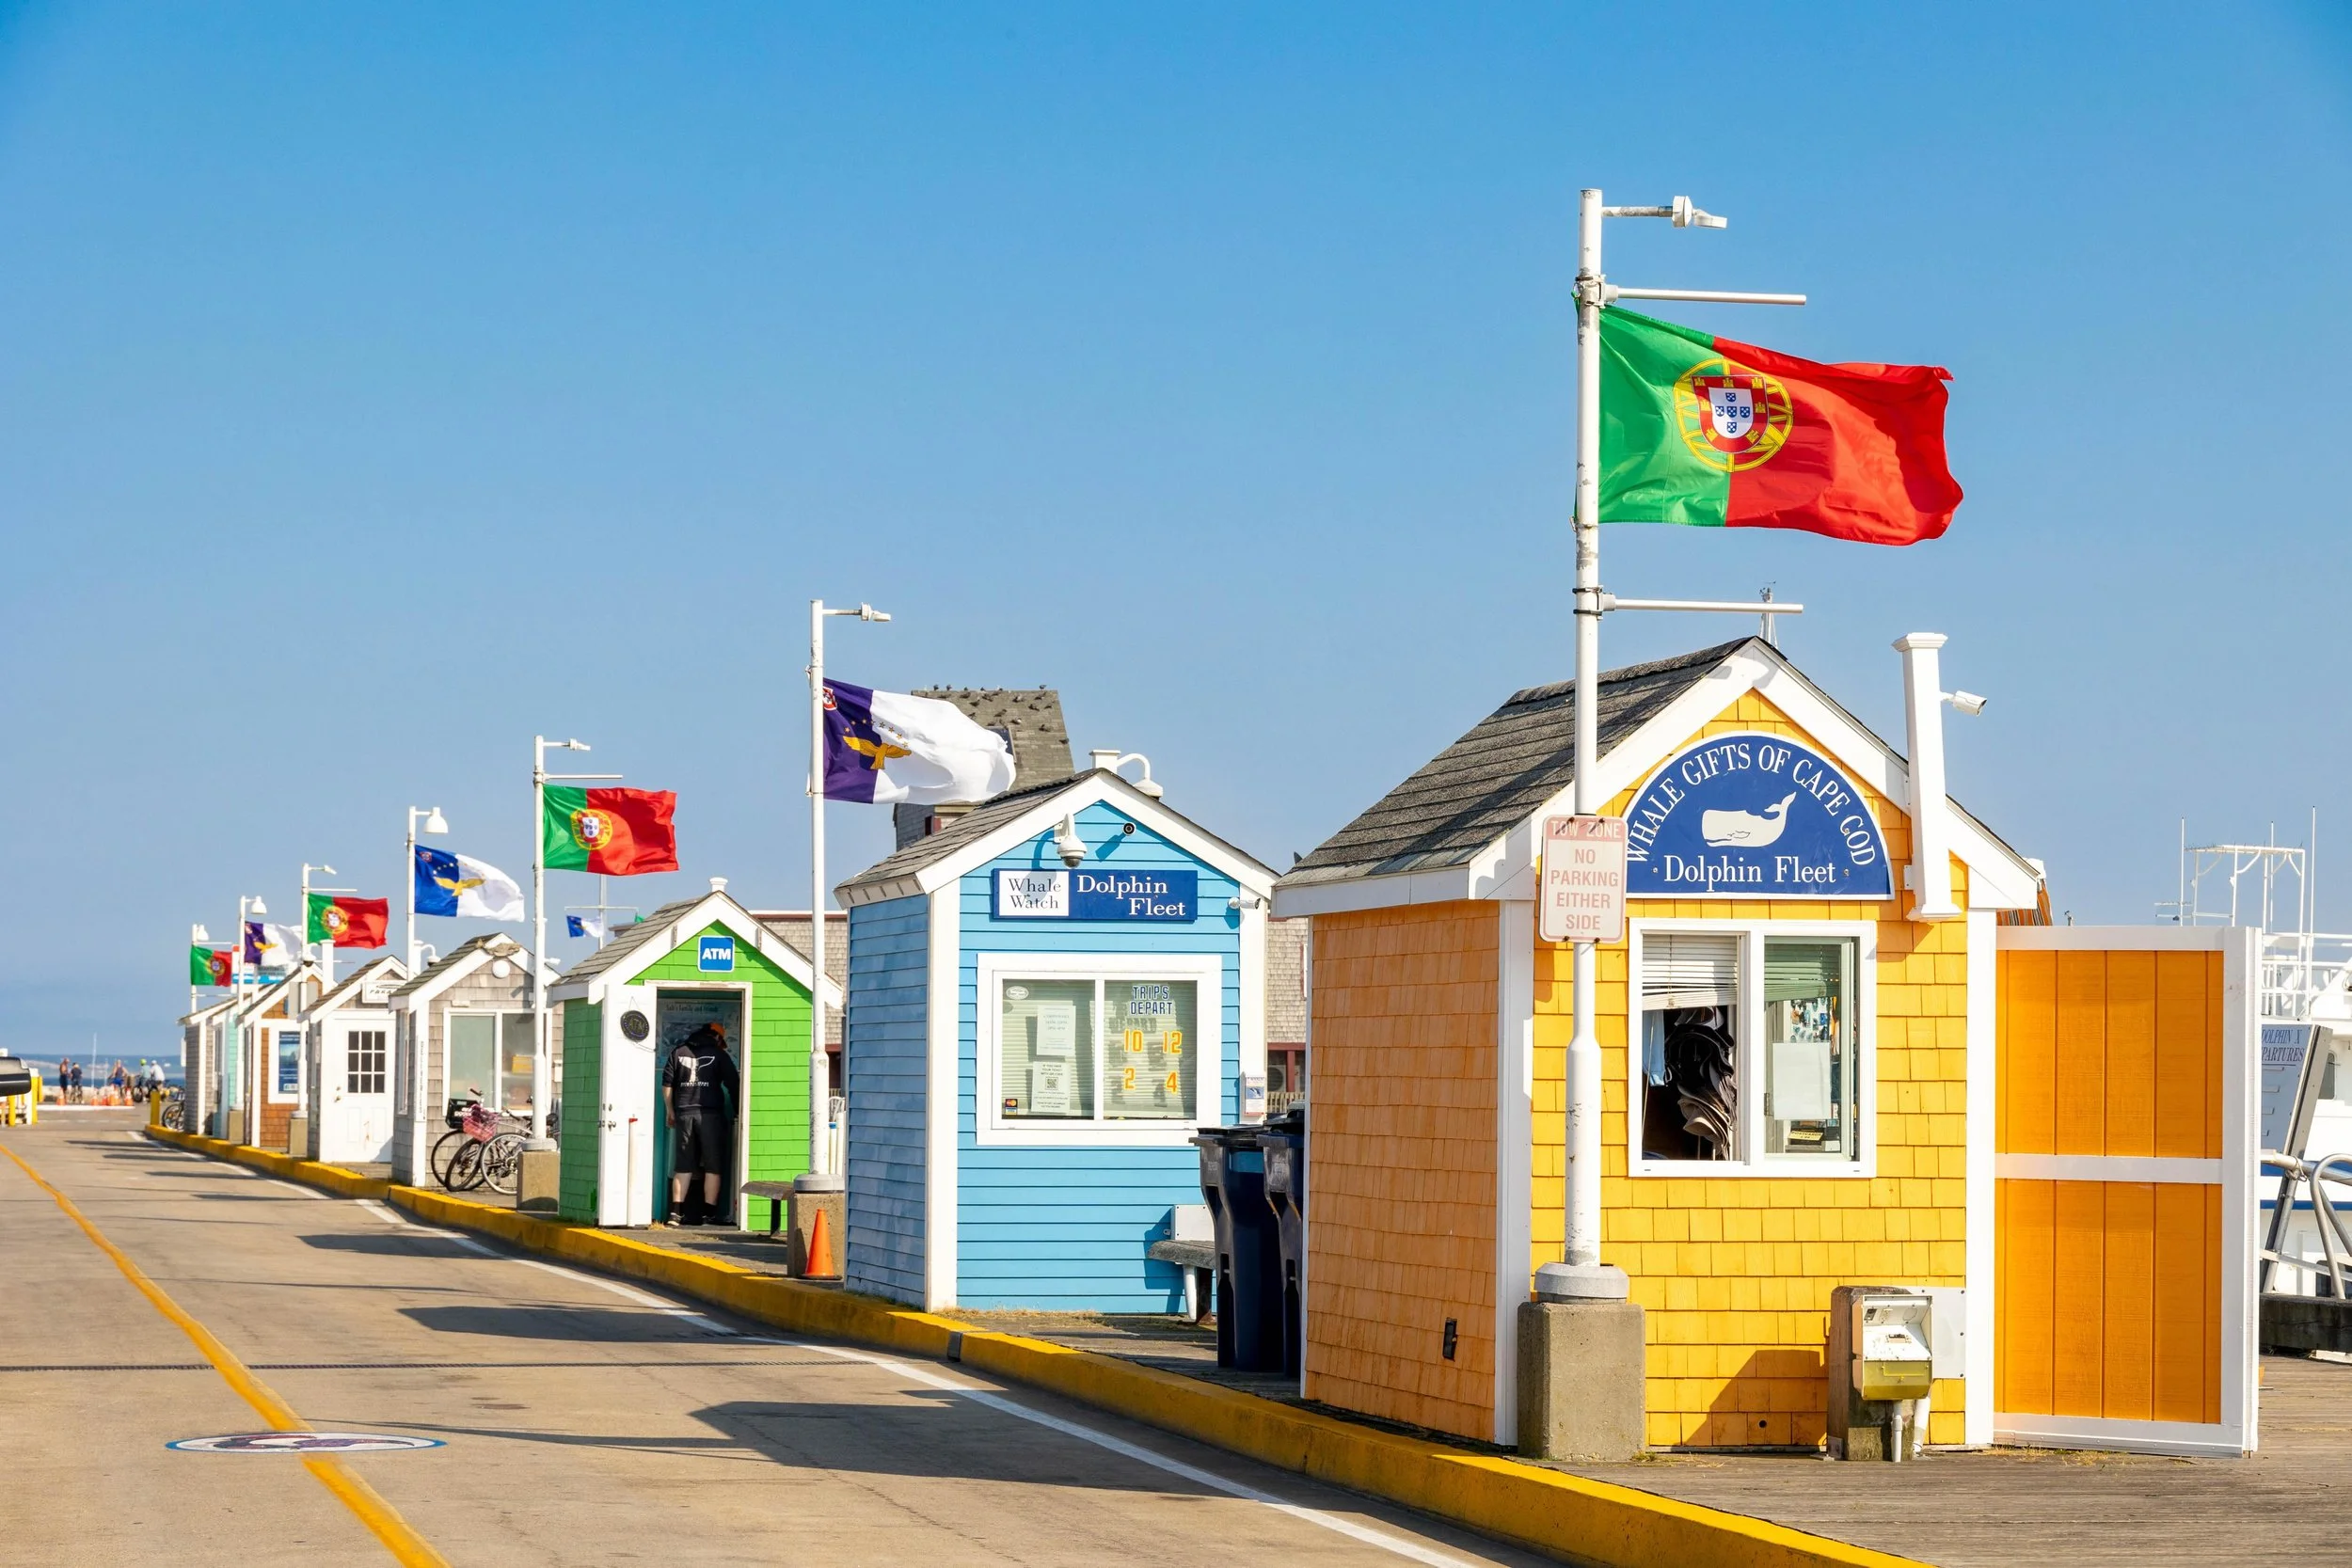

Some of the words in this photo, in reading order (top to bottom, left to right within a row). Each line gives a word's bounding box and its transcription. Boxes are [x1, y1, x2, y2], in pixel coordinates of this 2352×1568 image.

[1627, 778, 1685, 863] WHALE
[1681, 743, 1751, 786] GIFTS
[1757, 744, 1791, 774] OF
[1793, 758, 1851, 818] CAPE
[1550, 820, 1580, 837] TOW
[1586, 822, 1621, 839] ZONE
[1574, 848, 1596, 864] NO
[1550, 869, 1619, 887] PARKING
[1664, 854, 1763, 892] Dolphin
[1774, 855, 1837, 883] Fleet
[1008, 878, 1062, 893] Whale
[1076, 875, 1168, 900] Dolphin
[1010, 895, 1059, 910] Watch
[1128, 897, 1186, 916] Fleet
[1556, 892, 1611, 909] EITHER
[1565, 913, 1601, 930] SIDE
[702, 947, 732, 960] ATM
[1132, 985, 1170, 1001] TRIPS
[1130, 1001, 1173, 1015] DEPART
[1124, 1030, 1143, 1053] 10
[1162, 1030, 1183, 1054] 12
[2262, 1029, 2293, 1044] DOLPHIN
[2262, 1047, 2305, 1062] PARTURES
[1123, 1068, 1136, 1090] 2
[1166, 1070, 1179, 1094] 4
